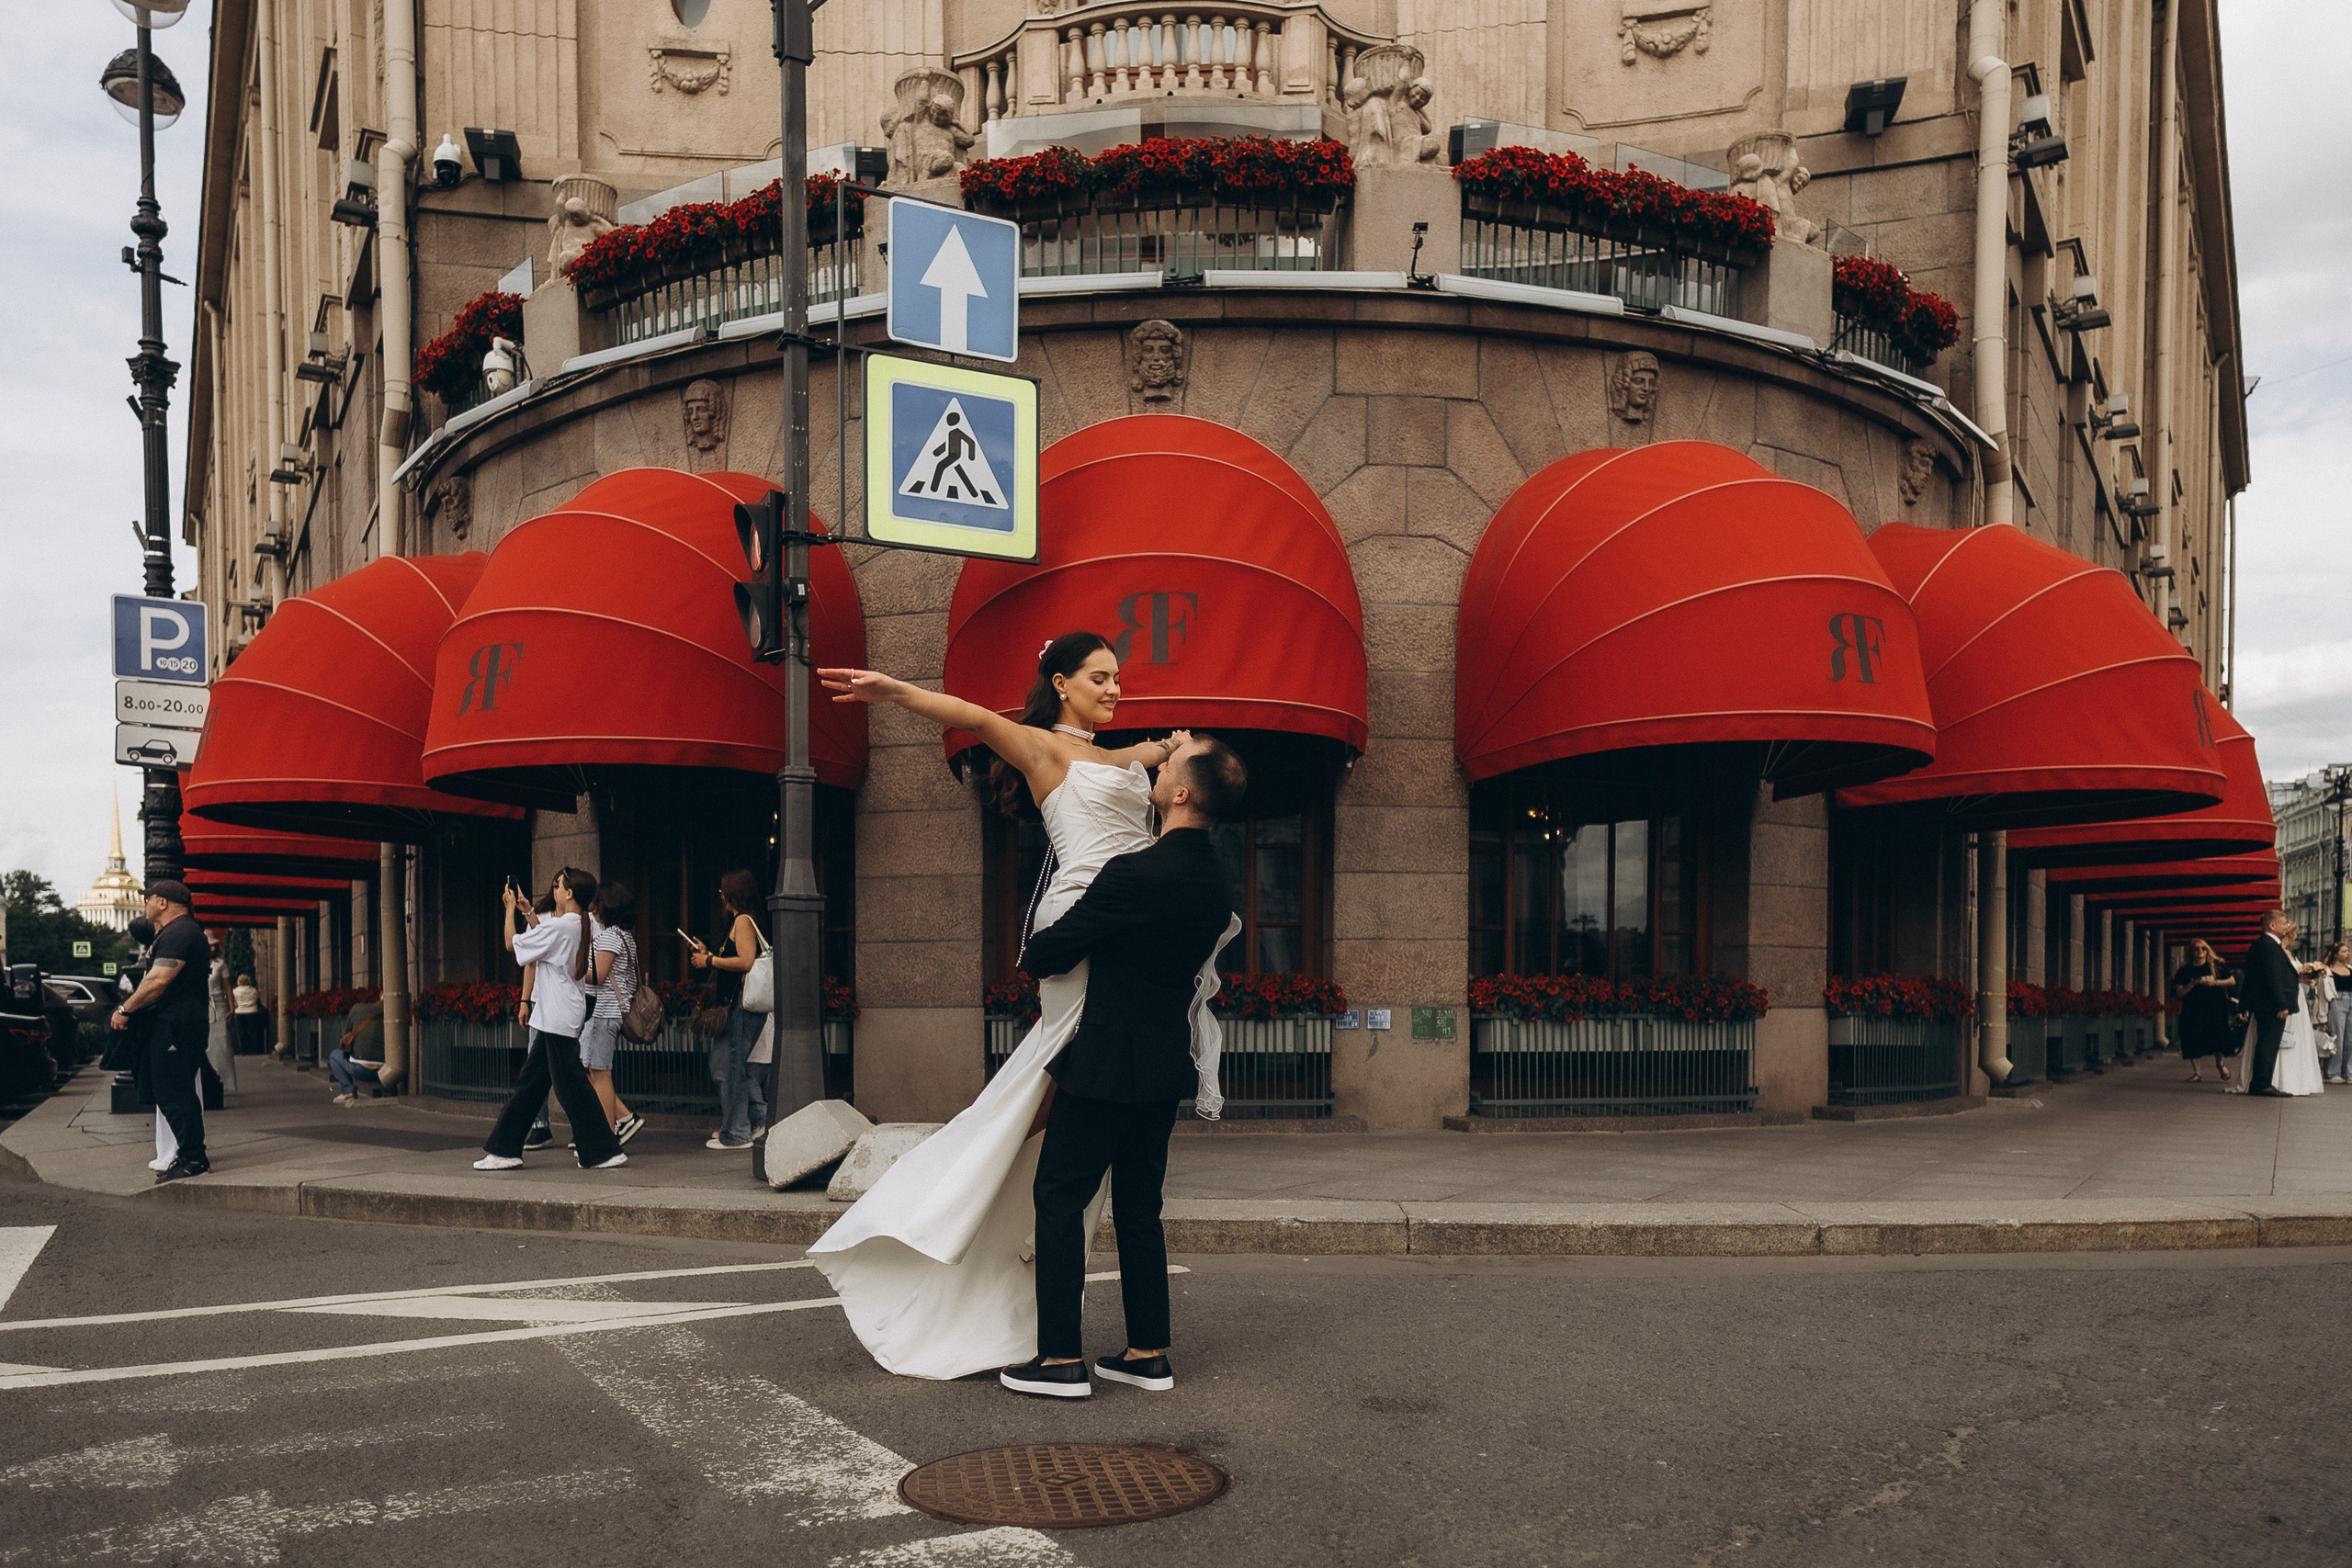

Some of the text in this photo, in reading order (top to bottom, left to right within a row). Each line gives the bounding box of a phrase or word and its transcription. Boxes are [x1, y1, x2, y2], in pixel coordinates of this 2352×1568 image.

[141, 605, 190, 671] P
[170, 660, 178, 668] 15
[183, 660, 197, 671] 20
[124, 695, 204, 715] 8.00-20.00
